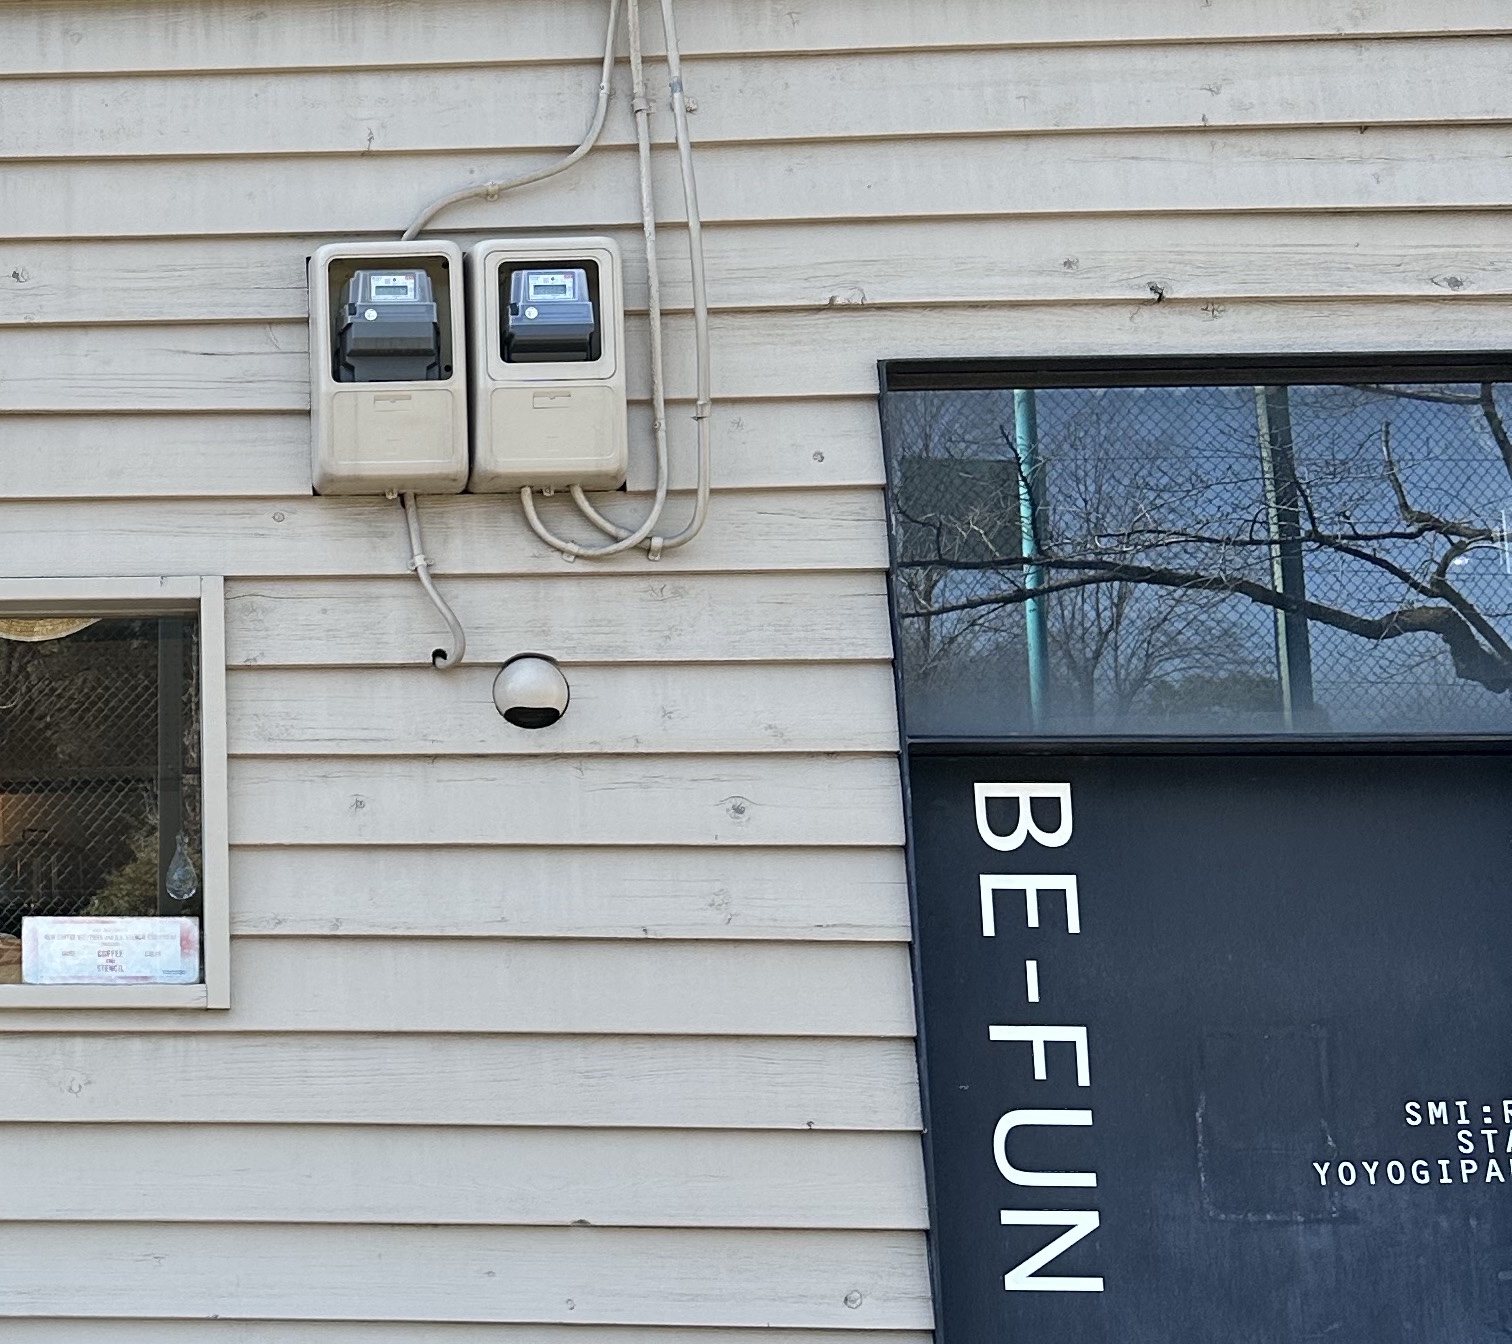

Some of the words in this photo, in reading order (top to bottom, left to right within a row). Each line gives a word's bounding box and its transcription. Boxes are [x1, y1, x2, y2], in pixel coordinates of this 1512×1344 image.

[974, 782, 1104, 1292] BE-FUN
[1457, 1129, 1512, 1154] ST
[1313, 1158, 1512, 1186] YOYOGIPA
